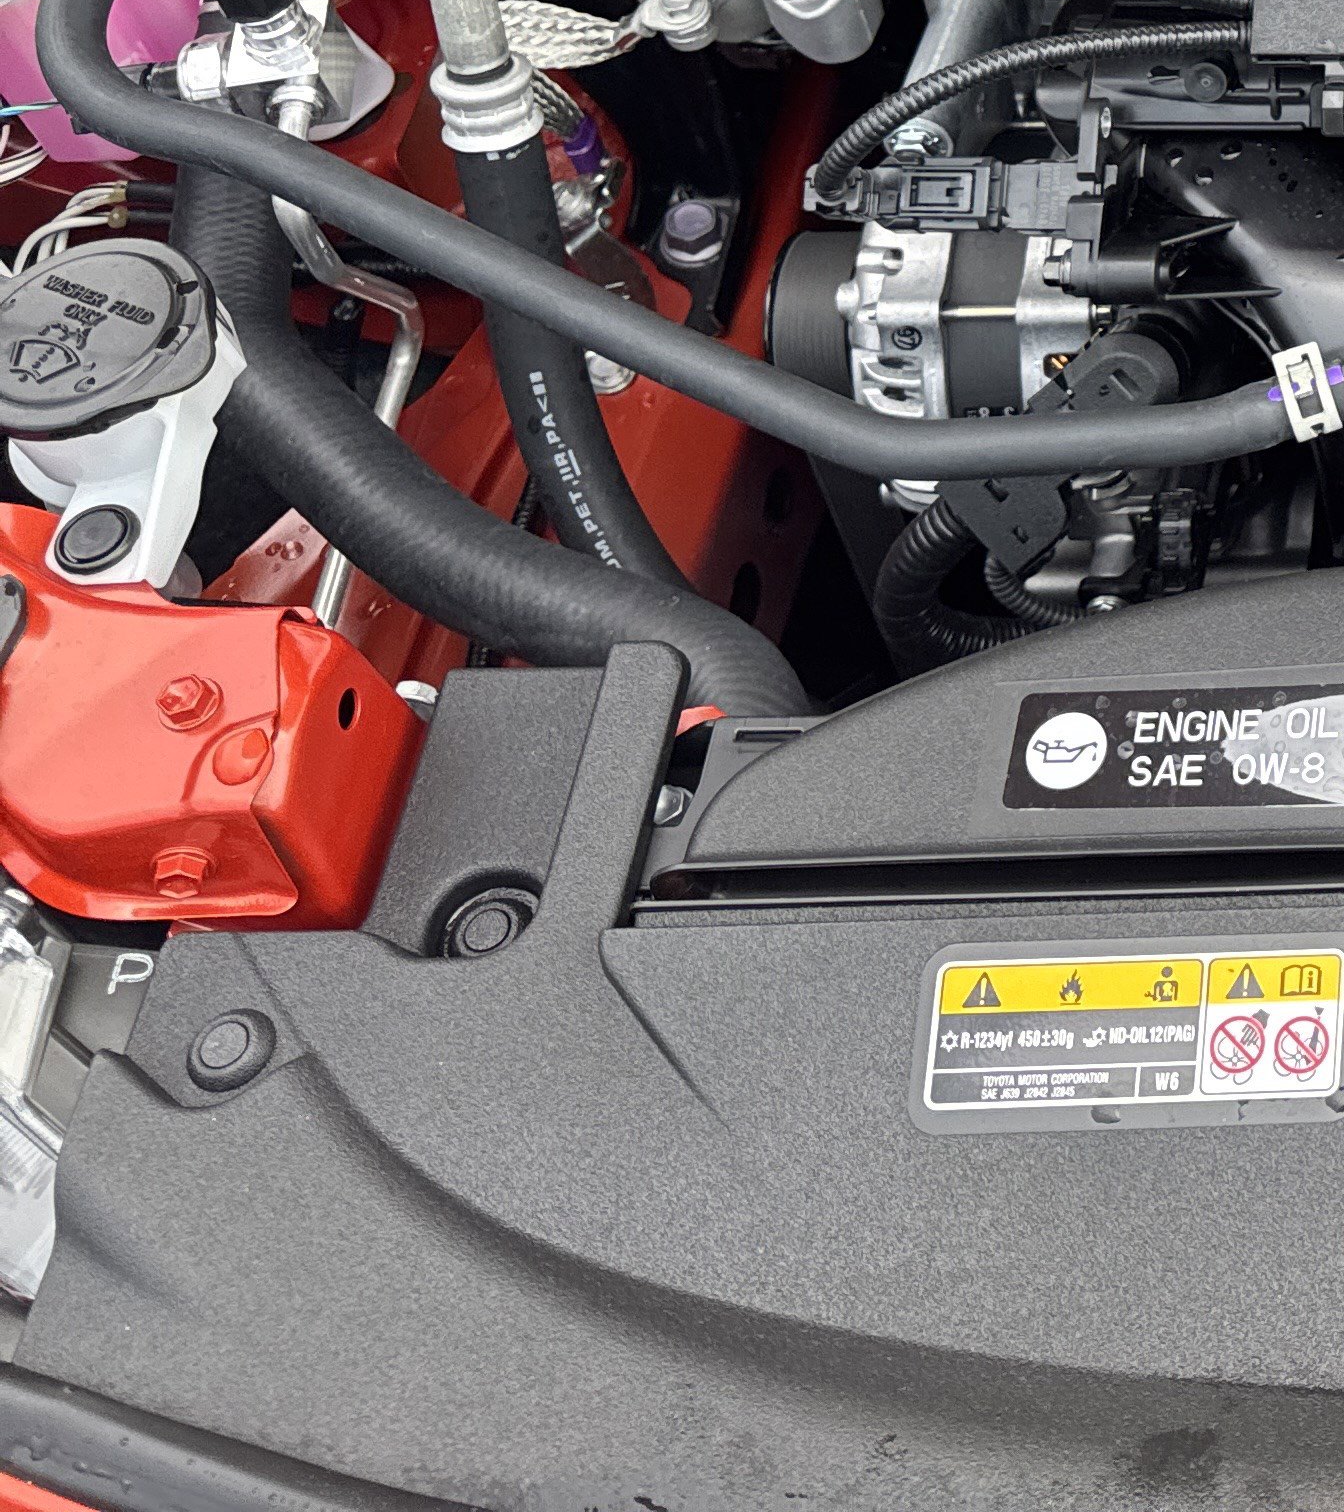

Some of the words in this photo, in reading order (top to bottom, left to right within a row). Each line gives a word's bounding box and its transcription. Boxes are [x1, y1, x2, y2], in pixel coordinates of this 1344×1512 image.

[43, 274, 109, 308] WASHER
[107, 300, 156, 326] FLUID
[63, 303, 109, 328] ONLY
[1132, 708, 1264, 745] ENGINE
[1285, 706, 1341, 739] OIL
[1127, 754, 1207, 788] SAE
[1231, 752, 1327, 787] 0W-8
[107, 952, 155, 996] P
[960, 1031, 1014, 1051] R-1234yf
[1017, 1029, 1075, 1049] 450±30g
[982, 1075, 1015, 1088] TOYOTA
[1017, 1074, 1048, 1087] MOTOR
[1050, 1072, 1109, 1086] CORPORATION
[1154, 1071, 1180, 1092] W6
[980, 1089, 997, 1100] SAE
